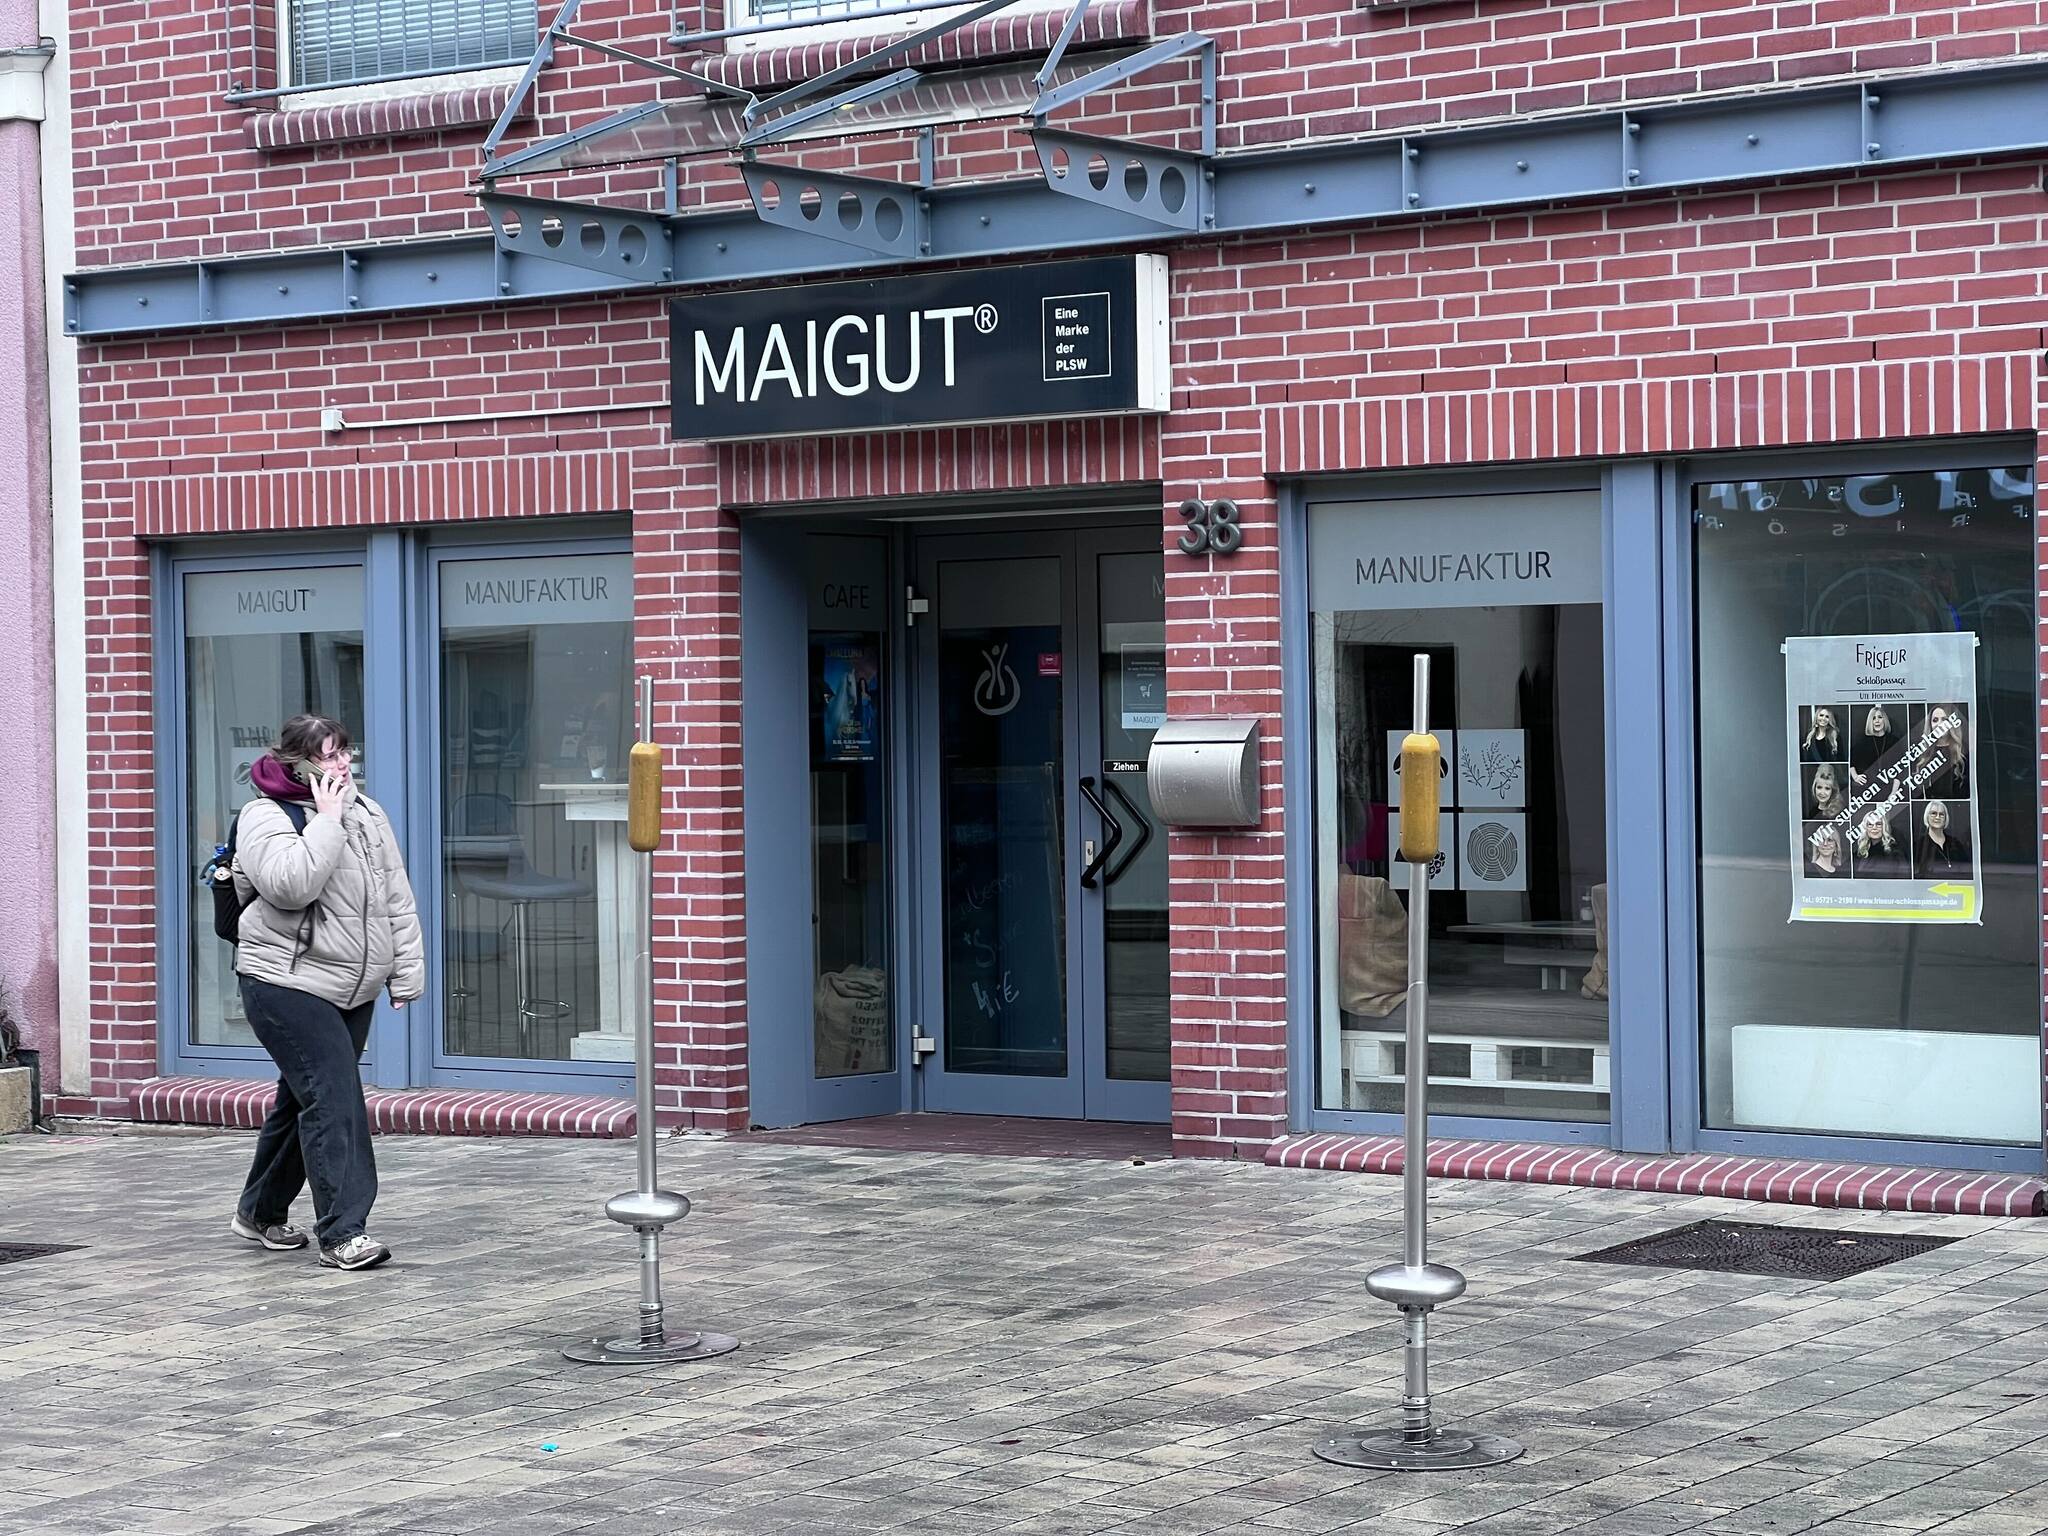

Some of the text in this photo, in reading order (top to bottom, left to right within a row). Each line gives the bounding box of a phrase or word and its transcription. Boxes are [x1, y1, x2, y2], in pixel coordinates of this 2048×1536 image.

[1055, 308, 1078, 319] Eine
[1055, 324, 1089, 337] Marke
[1055, 343, 1075, 354] der
[1055, 358, 1087, 371] PLSW
[1178, 499, 1241, 554] 38
[1356, 551, 1552, 584] MANUFAKTUR
[465, 576, 609, 604] MANUFAKTUR
[823, 583, 870, 609] CAFE
[1113, 762, 1140, 771] Ziehen
[1808, 712, 1962, 847] Wir suchen Verstärkung
[1845, 818, 1869, 843] für
[1903, 750, 1948, 791] Team!
